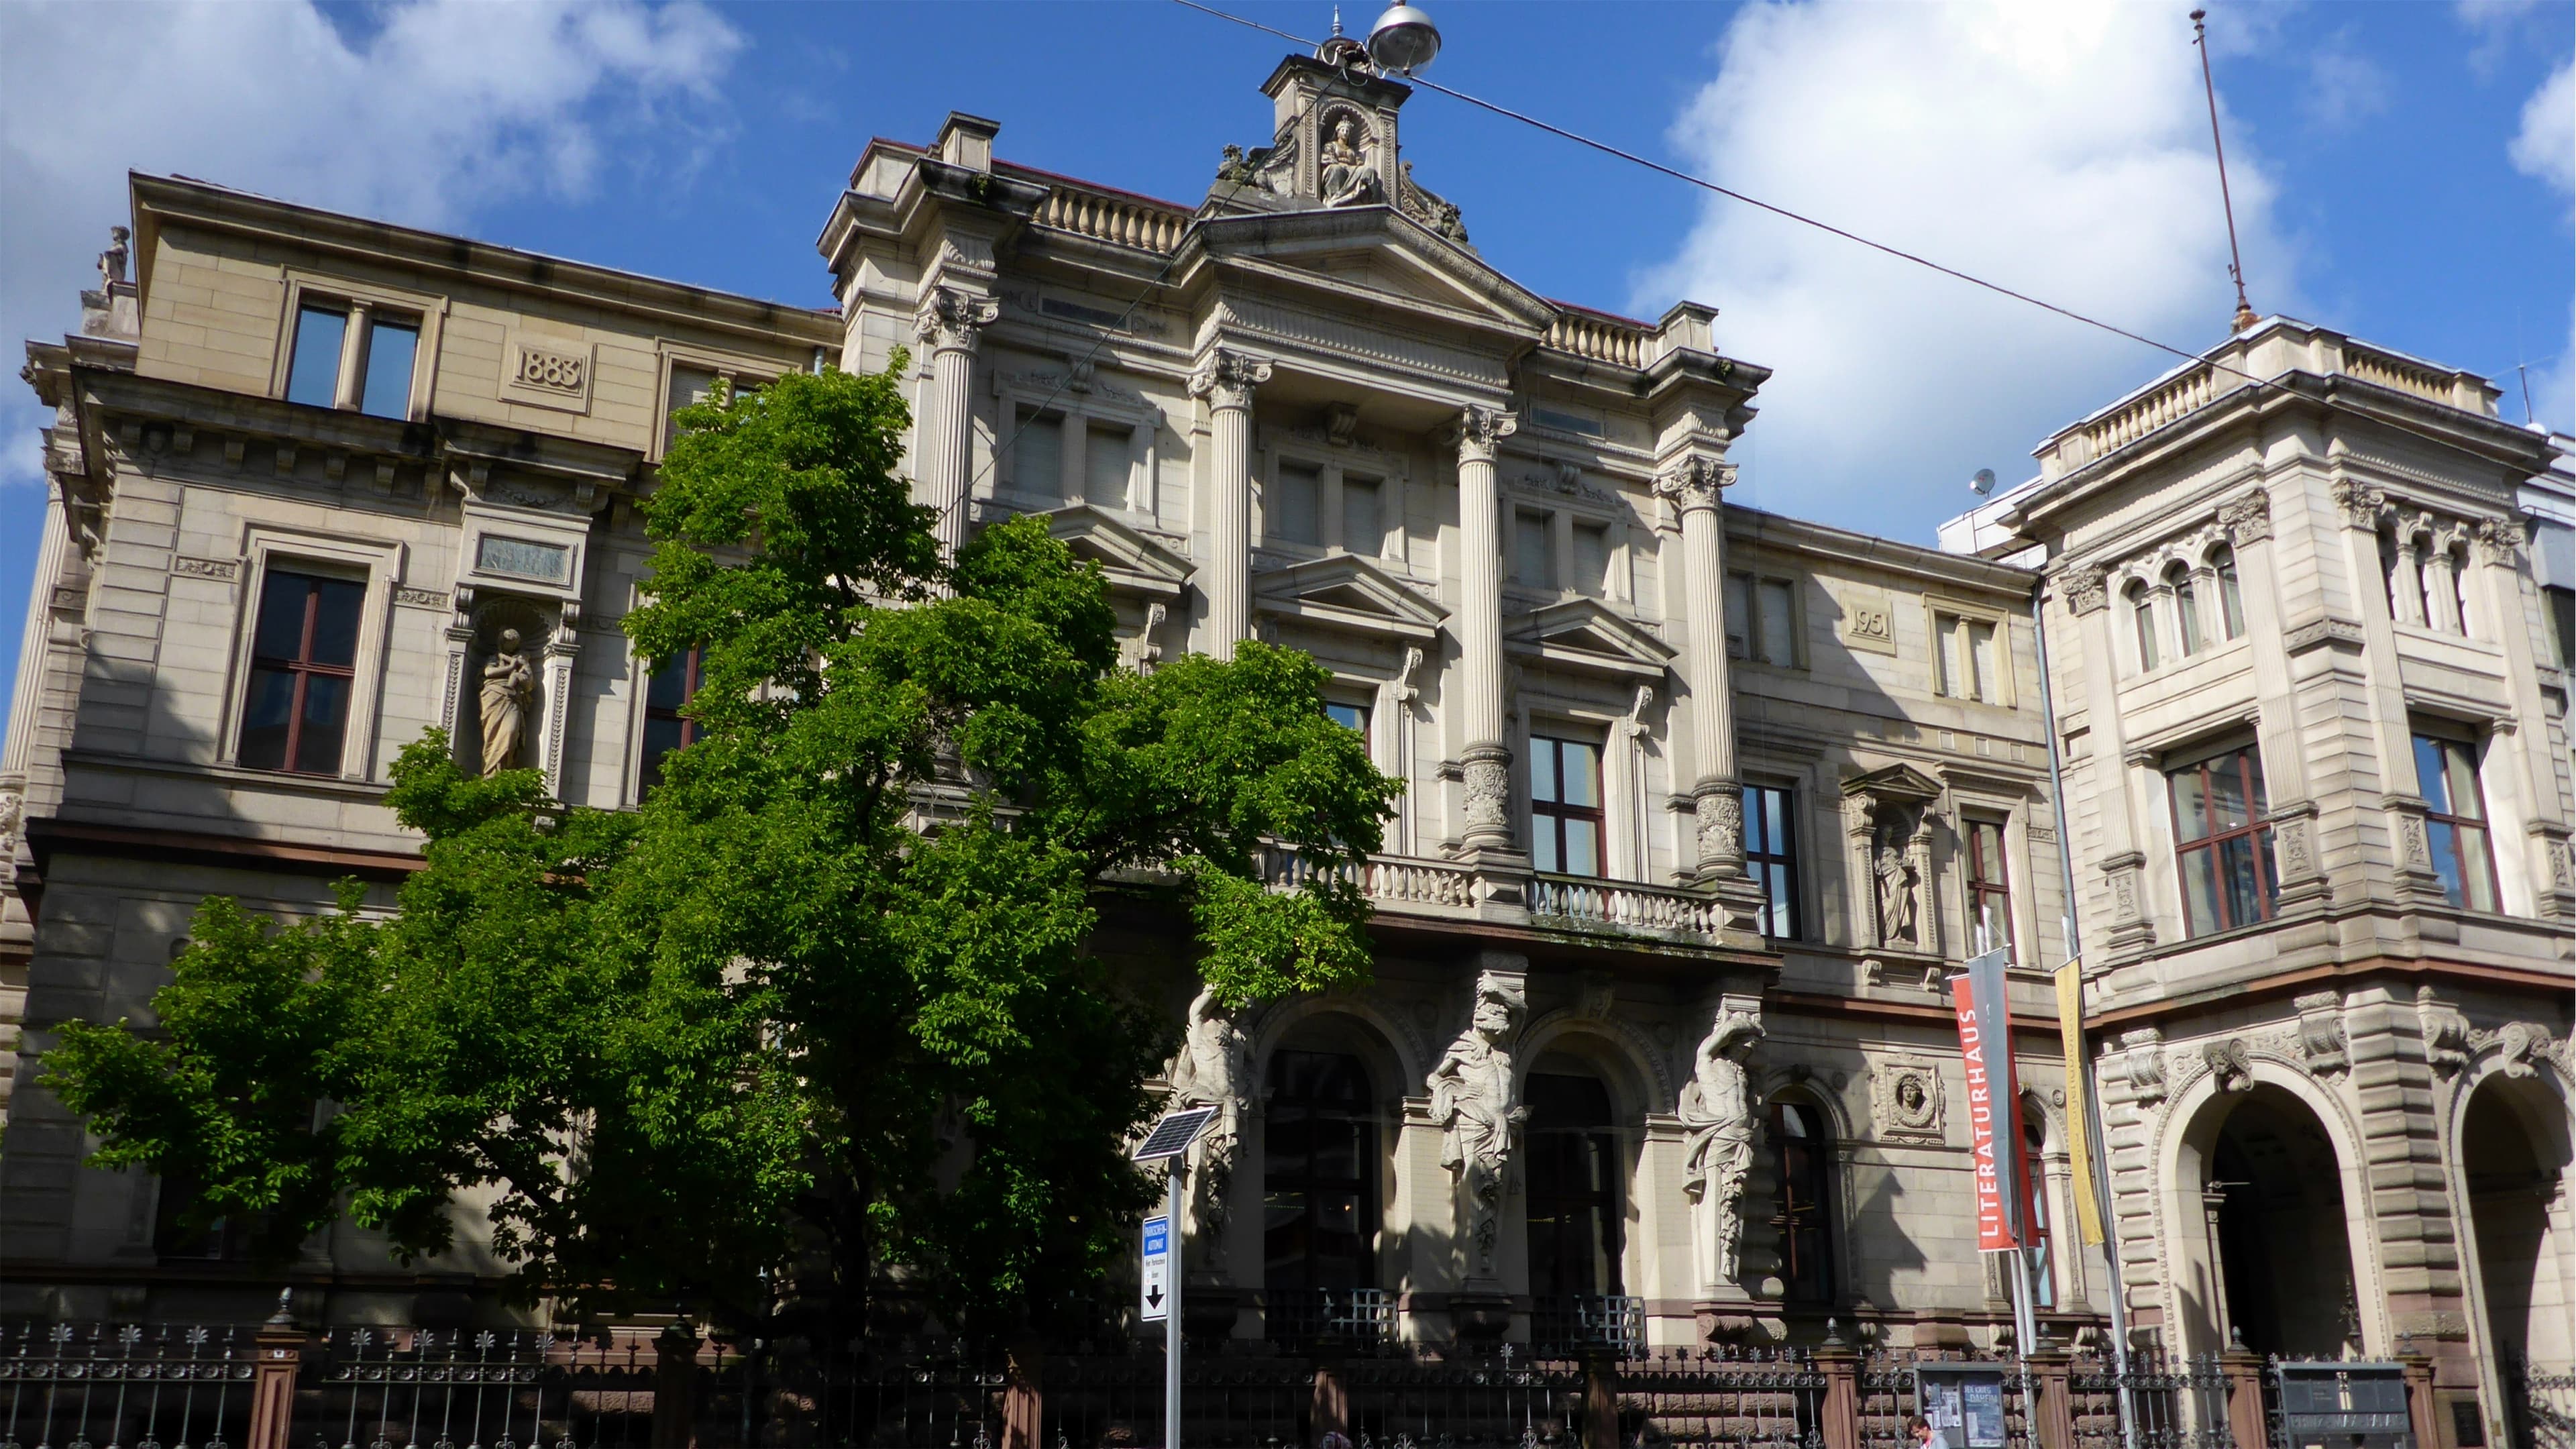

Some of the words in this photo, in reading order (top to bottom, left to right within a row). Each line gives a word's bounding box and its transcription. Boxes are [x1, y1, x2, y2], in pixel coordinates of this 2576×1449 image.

[516, 350, 582, 389] 1883
[1851, 608, 1890, 637] 1951
[1960, 1008, 2000, 1238] LITERATURHAUS
[1148, 1238, 1164, 1251] AUTOMAT
